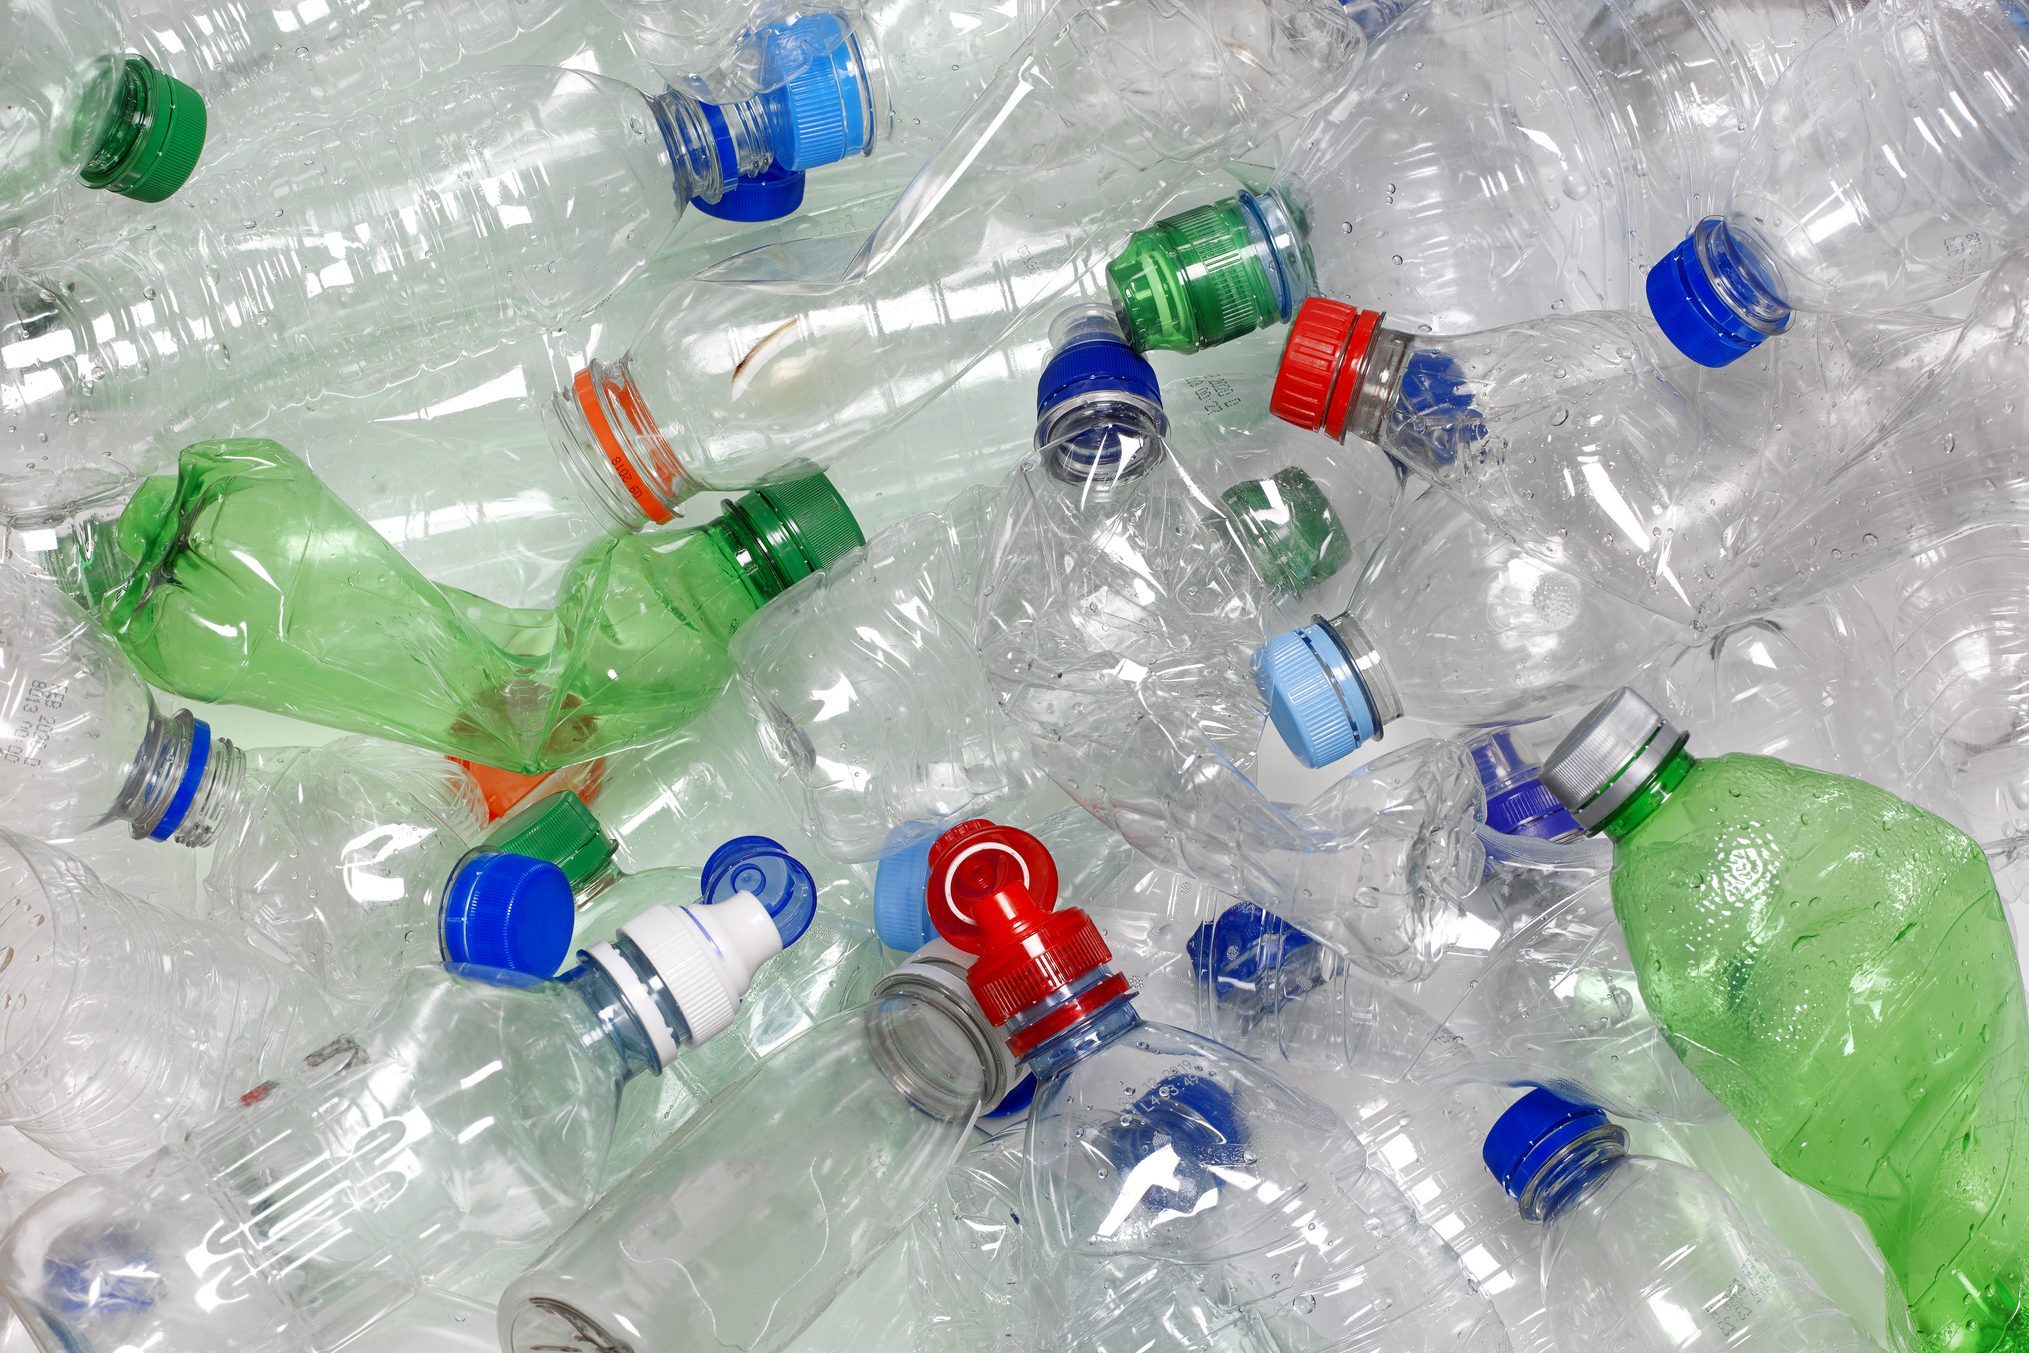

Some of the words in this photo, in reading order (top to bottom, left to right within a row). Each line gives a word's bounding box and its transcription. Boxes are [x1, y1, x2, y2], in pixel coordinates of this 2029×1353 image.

[611, 456, 633, 483] 2018
[629, 485, 643, 499] 09
[22, 679, 47, 714] 8013
